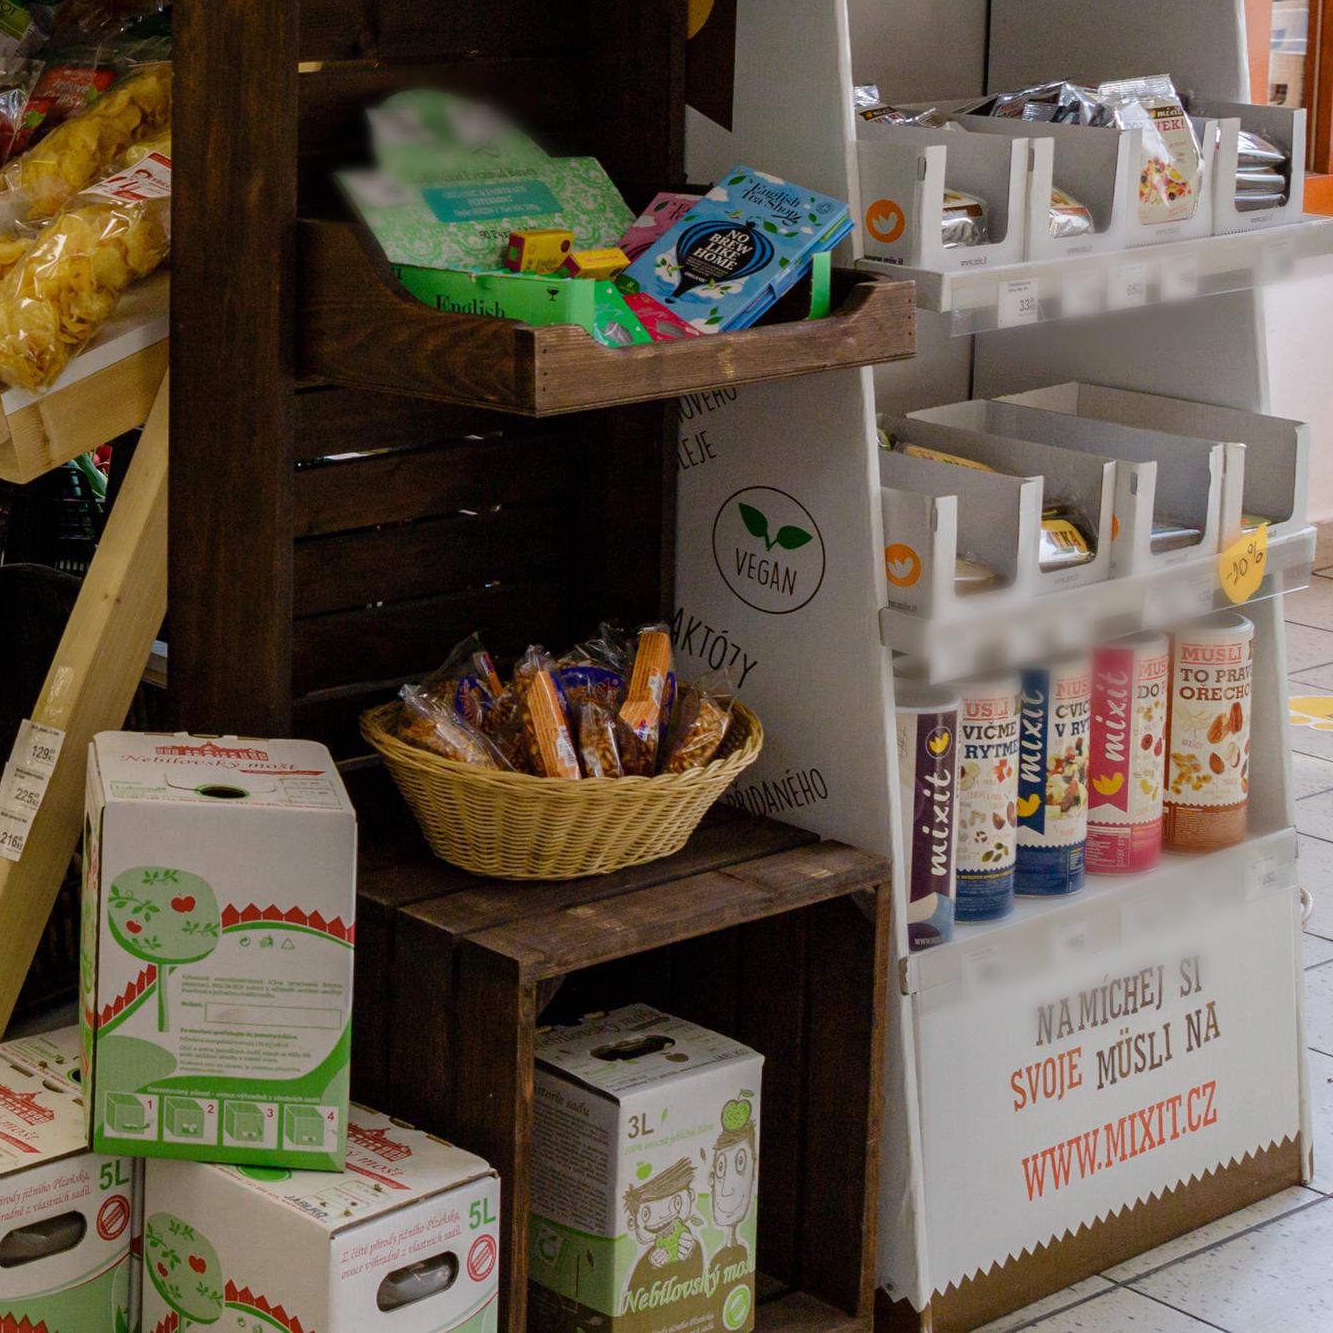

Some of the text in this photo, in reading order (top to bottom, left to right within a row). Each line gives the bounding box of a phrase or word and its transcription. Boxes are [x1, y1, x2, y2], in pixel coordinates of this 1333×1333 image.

[742, 187, 802, 220] Tea Shop
[751, 183, 801, 208] English
[709, 233, 754, 254] BREW
[726, 229, 750, 243] NO
[693, 247, 738, 271] HOME
[705, 242, 741, 262] LIKE
[435, 293, 505, 317] English
[677, 430, 717, 472] LEJE
[735, 547, 797, 596] VEGAN
[1180, 669, 1210, 682] TO
[1137, 683, 1159, 700] DO
[1096, 667, 1128, 762] mixit
[1020, 688, 1045, 784] mixit
[32, 745, 50, 760] 129
[15, 788, 34, 803] 225
[923, 767, 952, 877] mixit
[0, 832, 17, 847] 216
[1036, 955, 1203, 1047] NAMÍCHEJ SI
[1010, 1001, 1221, 1112] SVOJE MÜSLI NA
[147, 1099, 153, 1110] 1
[207, 1104, 214, 1114] 2
[267, 1108, 274, 1118] 3
[327, 1111, 334, 1120] 4
[628, 1112, 654, 1140] 3L
[1021, 1080, 1218, 1202] WWW.MIXIT.CZ
[99, 1159, 130, 1191] 5L
[33, 1192, 69, 1214] vlastních
[469, 1198, 496, 1230] 5L
[341, 1252, 349, 1264] Z
[621, 1262, 721, 1315] Nebílovský
